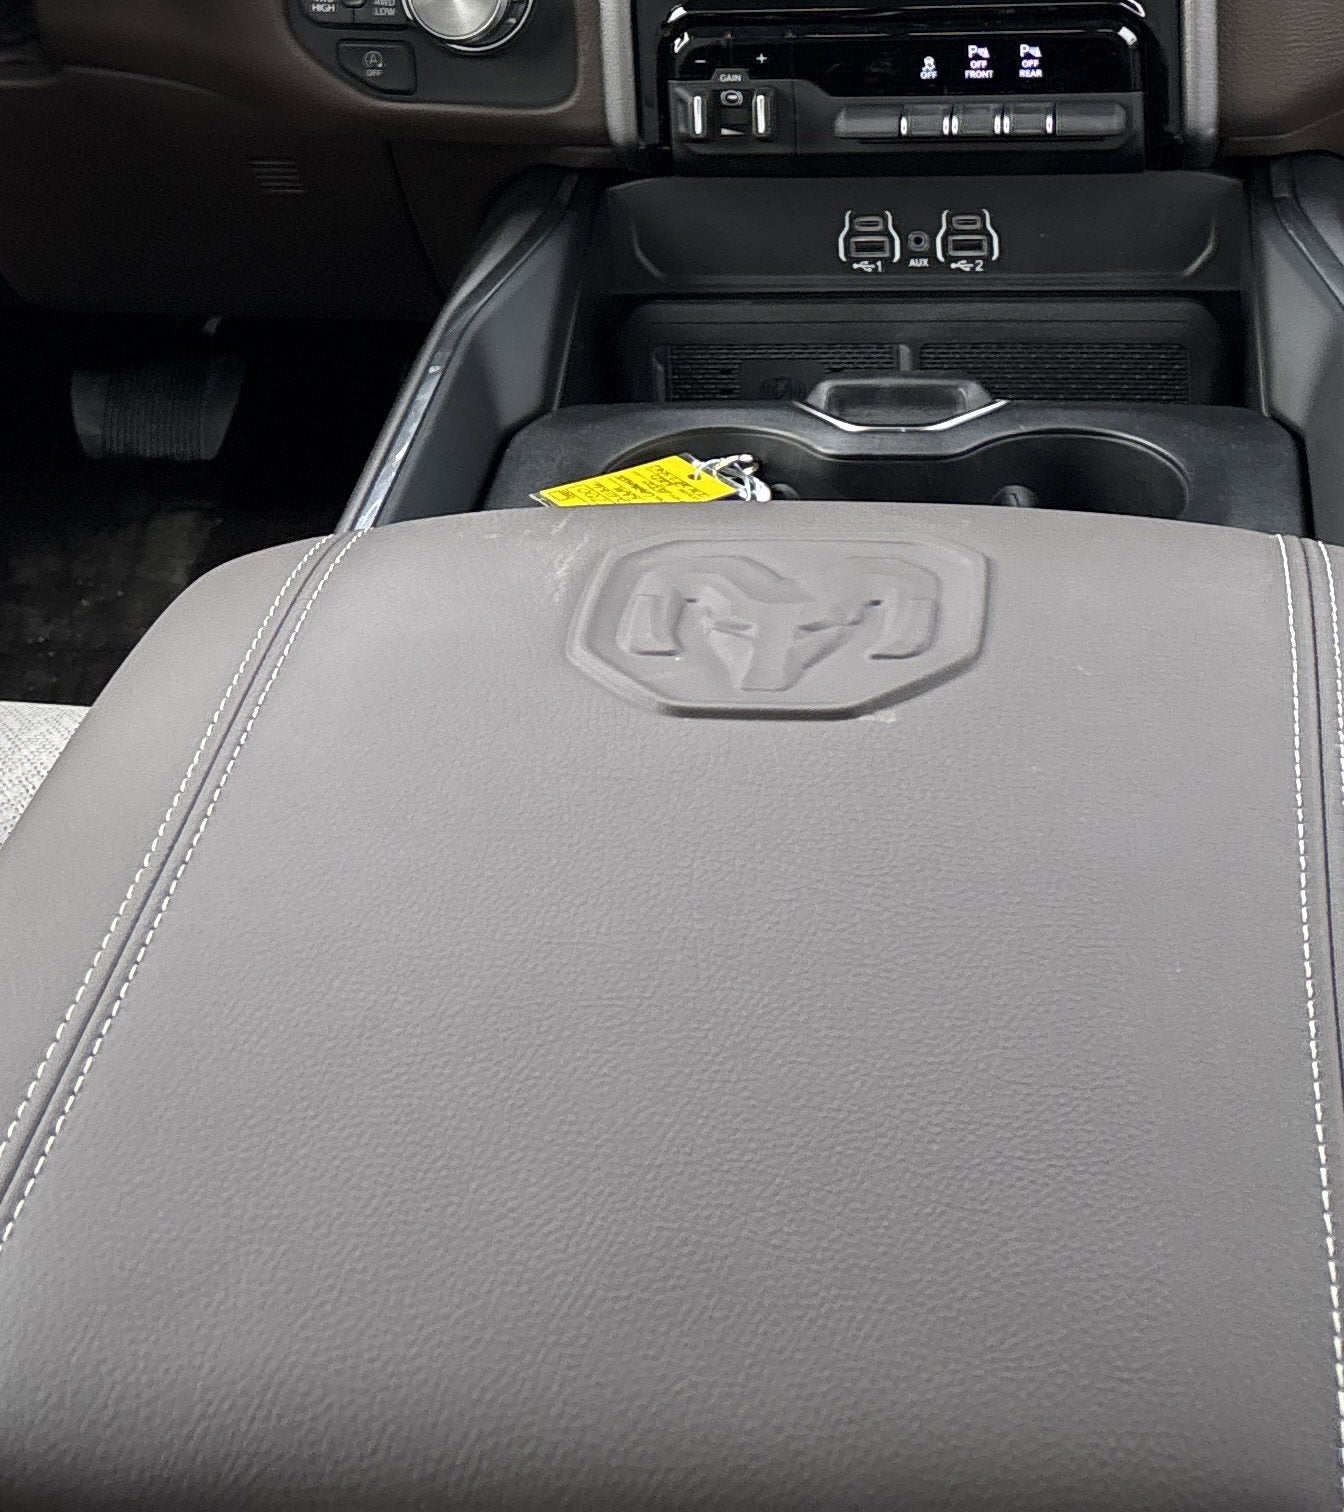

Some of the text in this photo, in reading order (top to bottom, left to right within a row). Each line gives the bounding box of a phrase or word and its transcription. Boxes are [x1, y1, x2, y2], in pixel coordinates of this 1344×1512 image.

[311, 3, 336, 13] HIGH
[374, 7, 397, 17] LOW
[969, 59, 988, 69] OFF
[1021, 59, 1040, 68] OFF
[719, 74, 742, 83] GAIN
[919, 70, 938, 80] OFF
[964, 69, 994, 79] FRONT
[1018, 69, 1043, 78] REAR
[908, 257, 930, 267] AUX
[974, 259, 984, 272] 2
